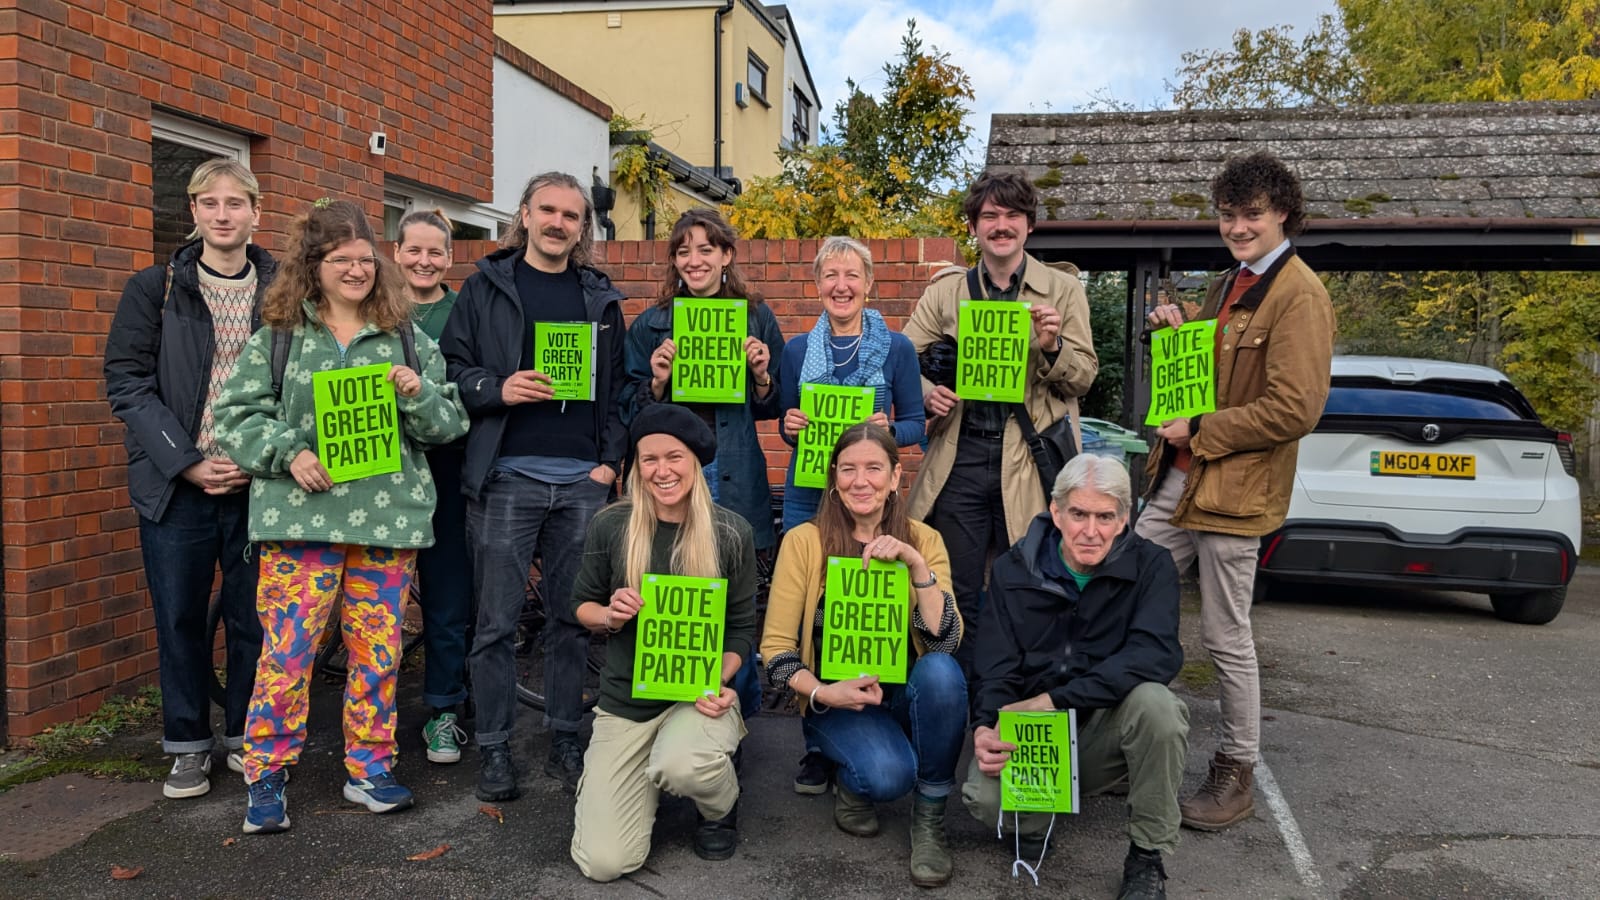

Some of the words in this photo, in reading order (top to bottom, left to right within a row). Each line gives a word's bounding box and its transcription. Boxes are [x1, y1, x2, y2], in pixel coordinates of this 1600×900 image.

[686, 307, 736, 333] VOTE
[971, 309, 1020, 334] VOTE
[547, 332, 579, 348] VOTE
[678, 335, 742, 361] GREEN
[962, 336, 1024, 362] GREEN
[1161, 328, 1204, 360] VOTE
[542, 349, 583, 365] GREEN
[543, 365, 582, 381] PARTY
[677, 363, 741, 389] PARTY
[961, 363, 1022, 389] PARTY
[1156, 352, 1209, 389] GREEN
[328, 373, 384, 407] VOTE
[1155, 380, 1209, 416] PARTY
[813, 393, 863, 421] VOTE
[322, 402, 393, 439] GREEN
[804, 421, 852, 447] GRE
[325, 432, 394, 469] PARTY
[1384, 453, 1431, 471] MG04
[1437, 455, 1472, 473] OXF
[841, 567, 896, 599] VOTE
[655, 585, 714, 618] VOTE
[829, 600, 903, 633] GREEN
[642, 618, 719, 653] GREEN
[828, 633, 902, 667] PARTY
[640, 652, 717, 686] PARTY
[1014, 723, 1053, 743] VOTE
[1010, 745, 1059, 765] GREEN
[1011, 766, 1059, 786] PARTY
